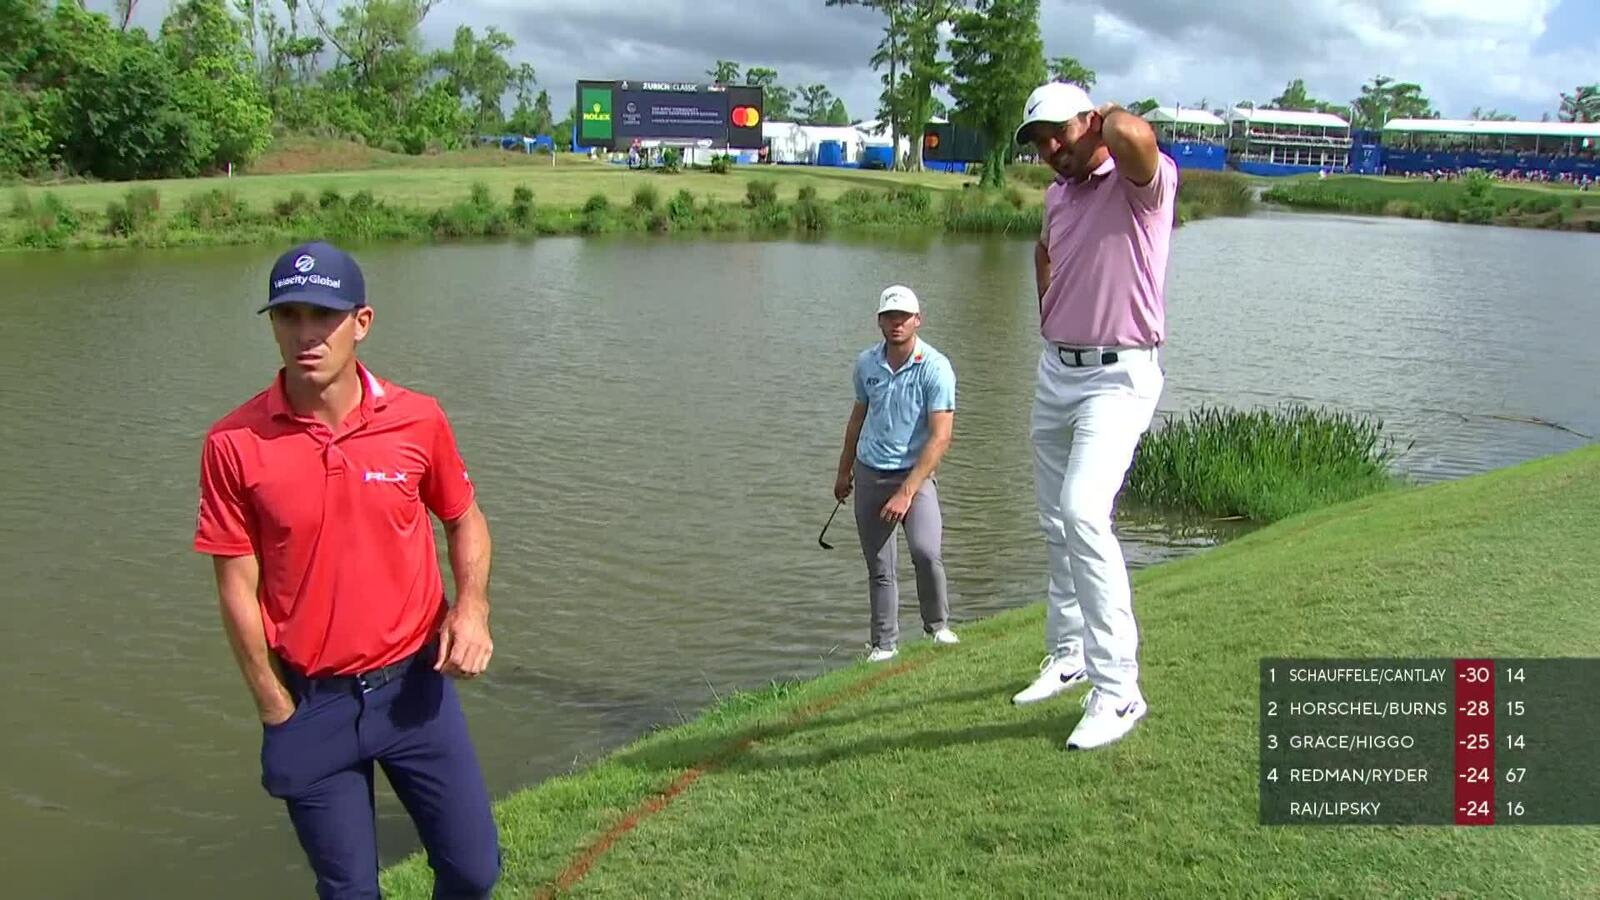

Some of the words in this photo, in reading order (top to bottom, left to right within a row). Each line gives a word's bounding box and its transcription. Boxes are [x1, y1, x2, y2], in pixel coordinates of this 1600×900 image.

[642, 82, 670, 91] ZURICH
[672, 82, 698, 92] CLASSIC
[309, 274, 341, 289] Global
[364, 471, 408, 483] RLX
